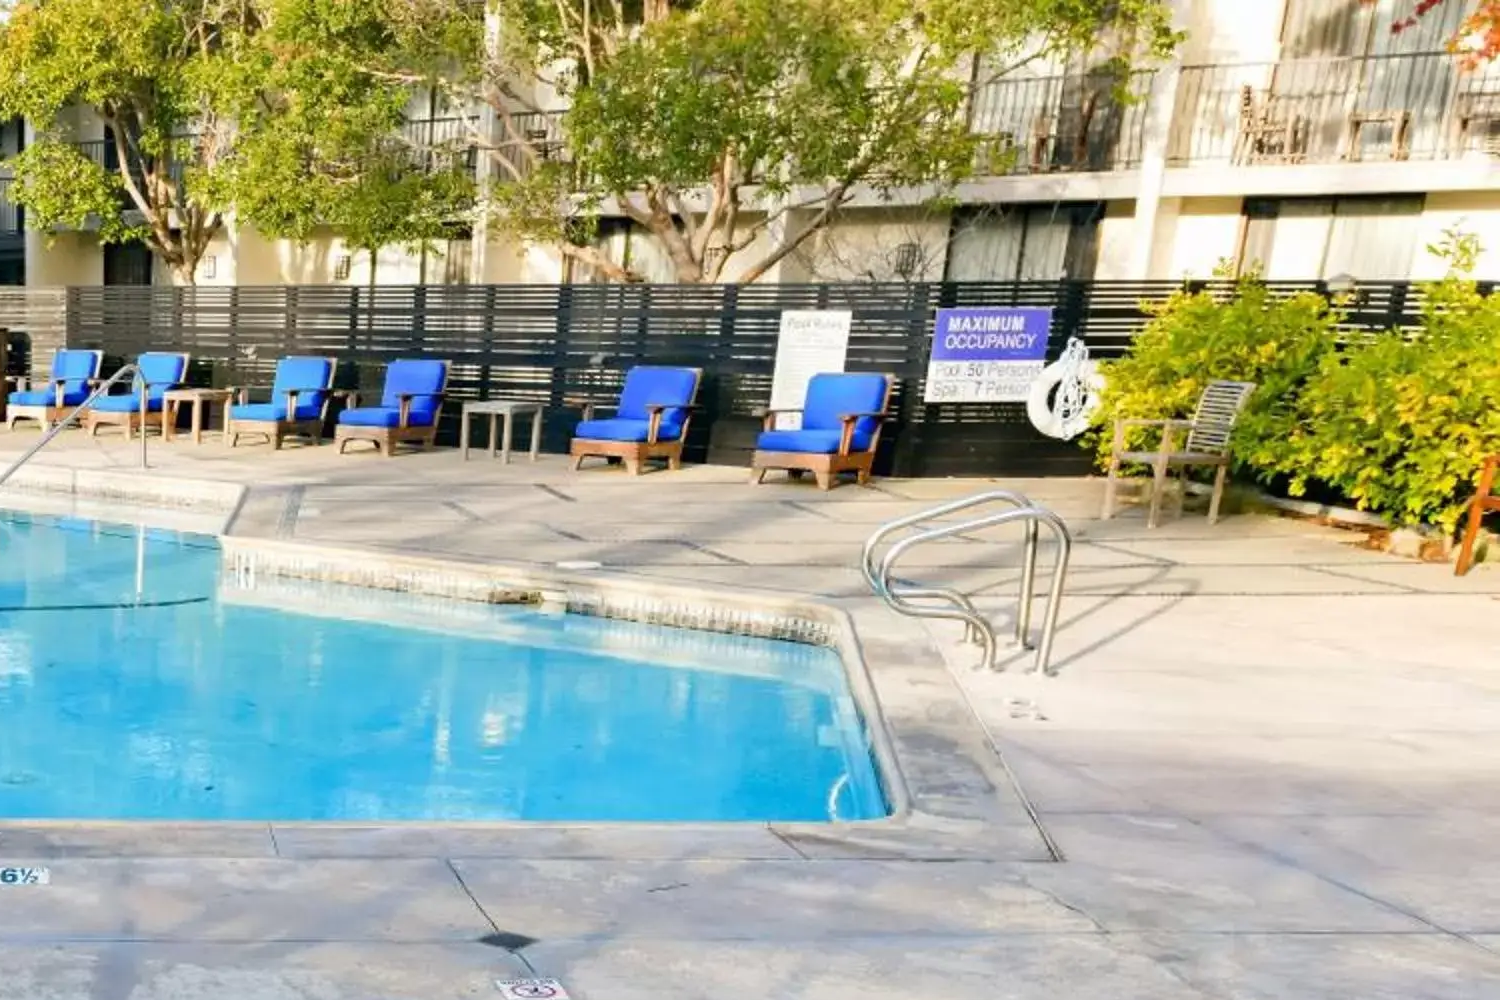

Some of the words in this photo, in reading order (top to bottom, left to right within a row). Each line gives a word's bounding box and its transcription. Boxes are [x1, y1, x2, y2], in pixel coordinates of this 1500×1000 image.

[947, 315, 1025, 332] MAXIMUM
[945, 333, 1038, 349] OCCUPANCY
[967, 363, 985, 377] 50
[974, 381, 983, 396] 7
